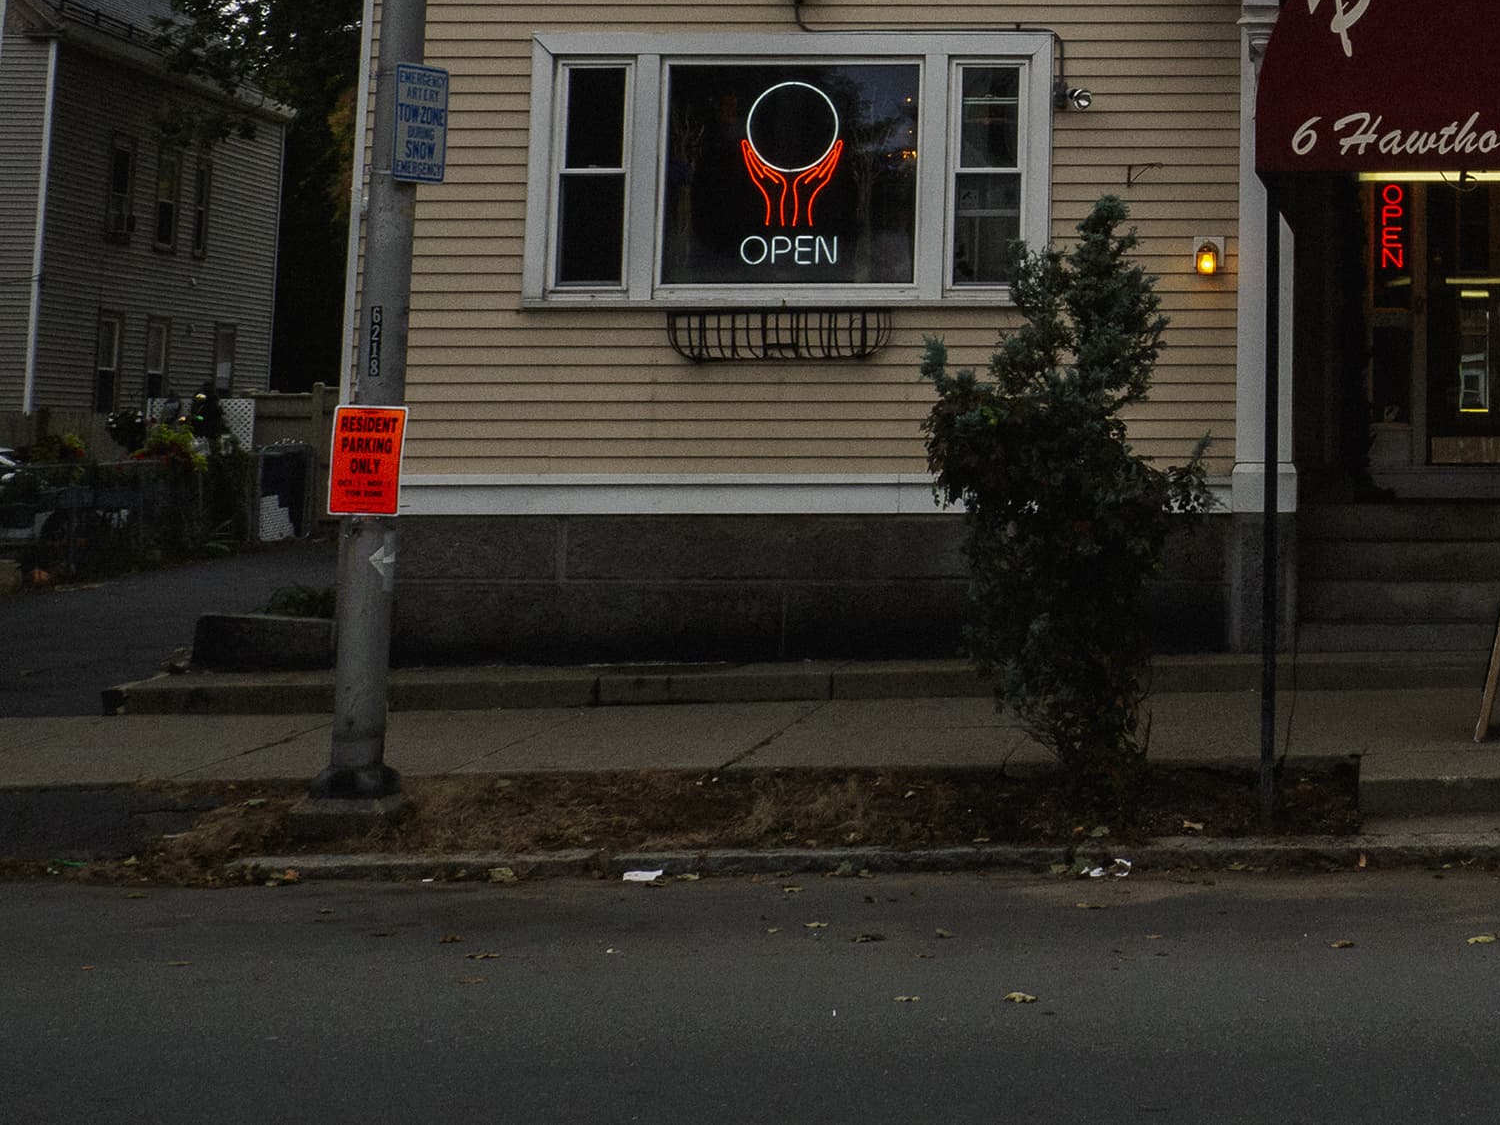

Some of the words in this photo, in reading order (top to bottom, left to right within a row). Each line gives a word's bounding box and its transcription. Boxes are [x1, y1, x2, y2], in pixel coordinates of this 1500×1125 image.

[399, 70, 446, 88] EMERGENCY
[407, 86, 440, 102] ARTERY
[1291, 116, 1323, 155] 6
[405, 140, 436, 160] SNOW
[396, 160, 442, 177] EMERGENCY
[1382, 184, 1404, 268] OPEN
[740, 235, 838, 265] OPEN
[369, 307, 382, 376] 6218
[341, 416, 399, 433] RESIDENT
[341, 437, 393, 454] PARKING
[350, 458, 380, 474] ONLY
